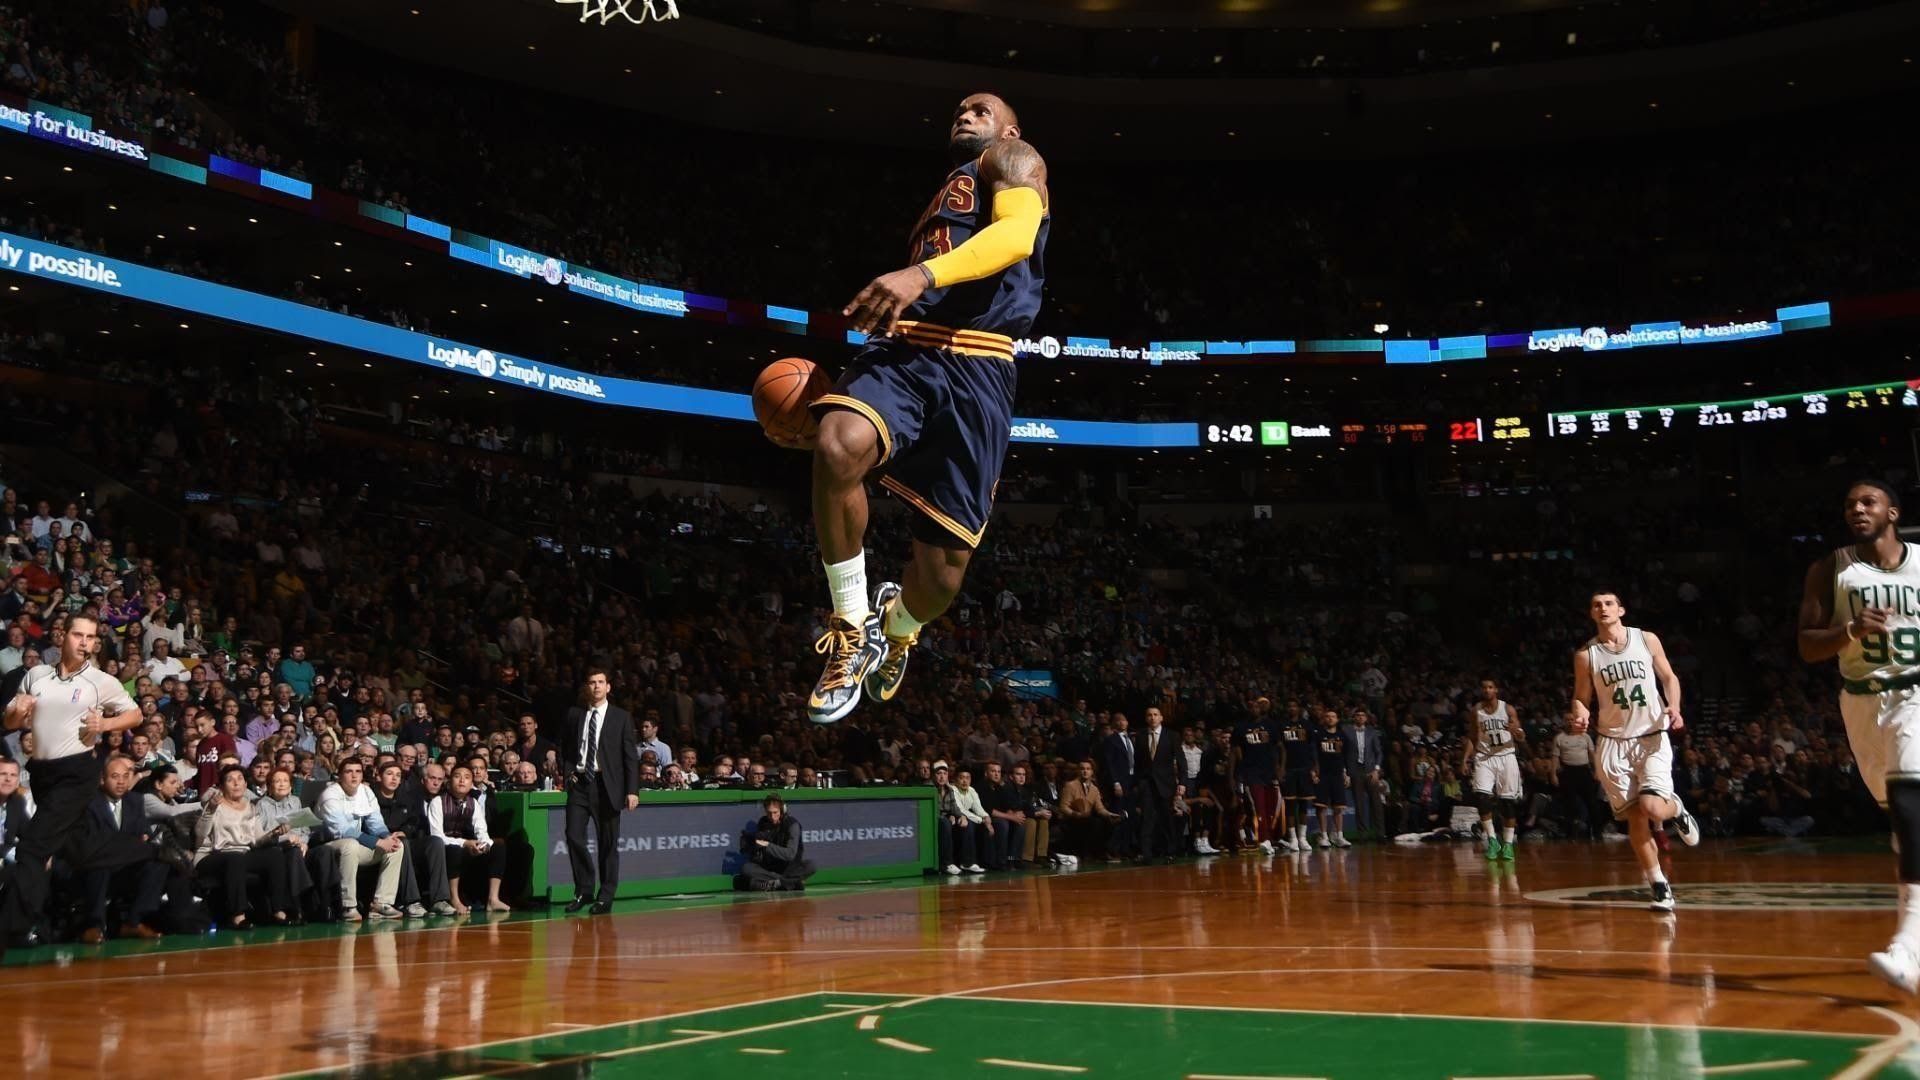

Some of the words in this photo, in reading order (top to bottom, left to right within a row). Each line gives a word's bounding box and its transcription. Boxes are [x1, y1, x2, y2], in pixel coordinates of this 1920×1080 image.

[34, 111, 64, 135] for
[67, 120, 148, 160] business.
[0, 238, 24, 268] ly
[29, 251, 122, 287] possible.
[563, 272, 614, 297] solutions
[614, 285, 631, 302] for
[632, 289, 690, 313] business.
[1610, 328, 1680, 344] solutions
[1680, 325, 1702, 339] for
[1703, 320, 1772, 337] business.
[1063, 344, 1120, 358] solutions
[1121, 347, 1140, 360] for
[1142, 346, 1201, 361] business.
[500, 358, 546, 388] Simply
[549, 374, 606, 399] possible.
[1560, 423, 1577, 434] 29
[1592, 420, 1610, 432] 12
[1628, 419, 1638, 430] 5
[1661, 416, 1672, 428] 7
[1698, 413, 1734, 425] 2/11
[1742, 407, 1787, 422] 23/53
[1806, 402, 1827, 414] 43
[1010, 422, 1059, 440] ssible.
[1208, 425, 1253, 442] 8:42
[1291, 425, 1331, 437] Bank
[1450, 422, 1478, 440] 22
[1861, 627, 1920, 665] 99
[1600, 660, 1646, 687] CELTICS
[1612, 684, 1647, 710] 44
[1489, 734, 1504, 747] 11
[553, 837, 652, 855] AECAN
[656, 833, 731, 850] EXPRESS
[857, 826, 914, 840] EXPRESS
